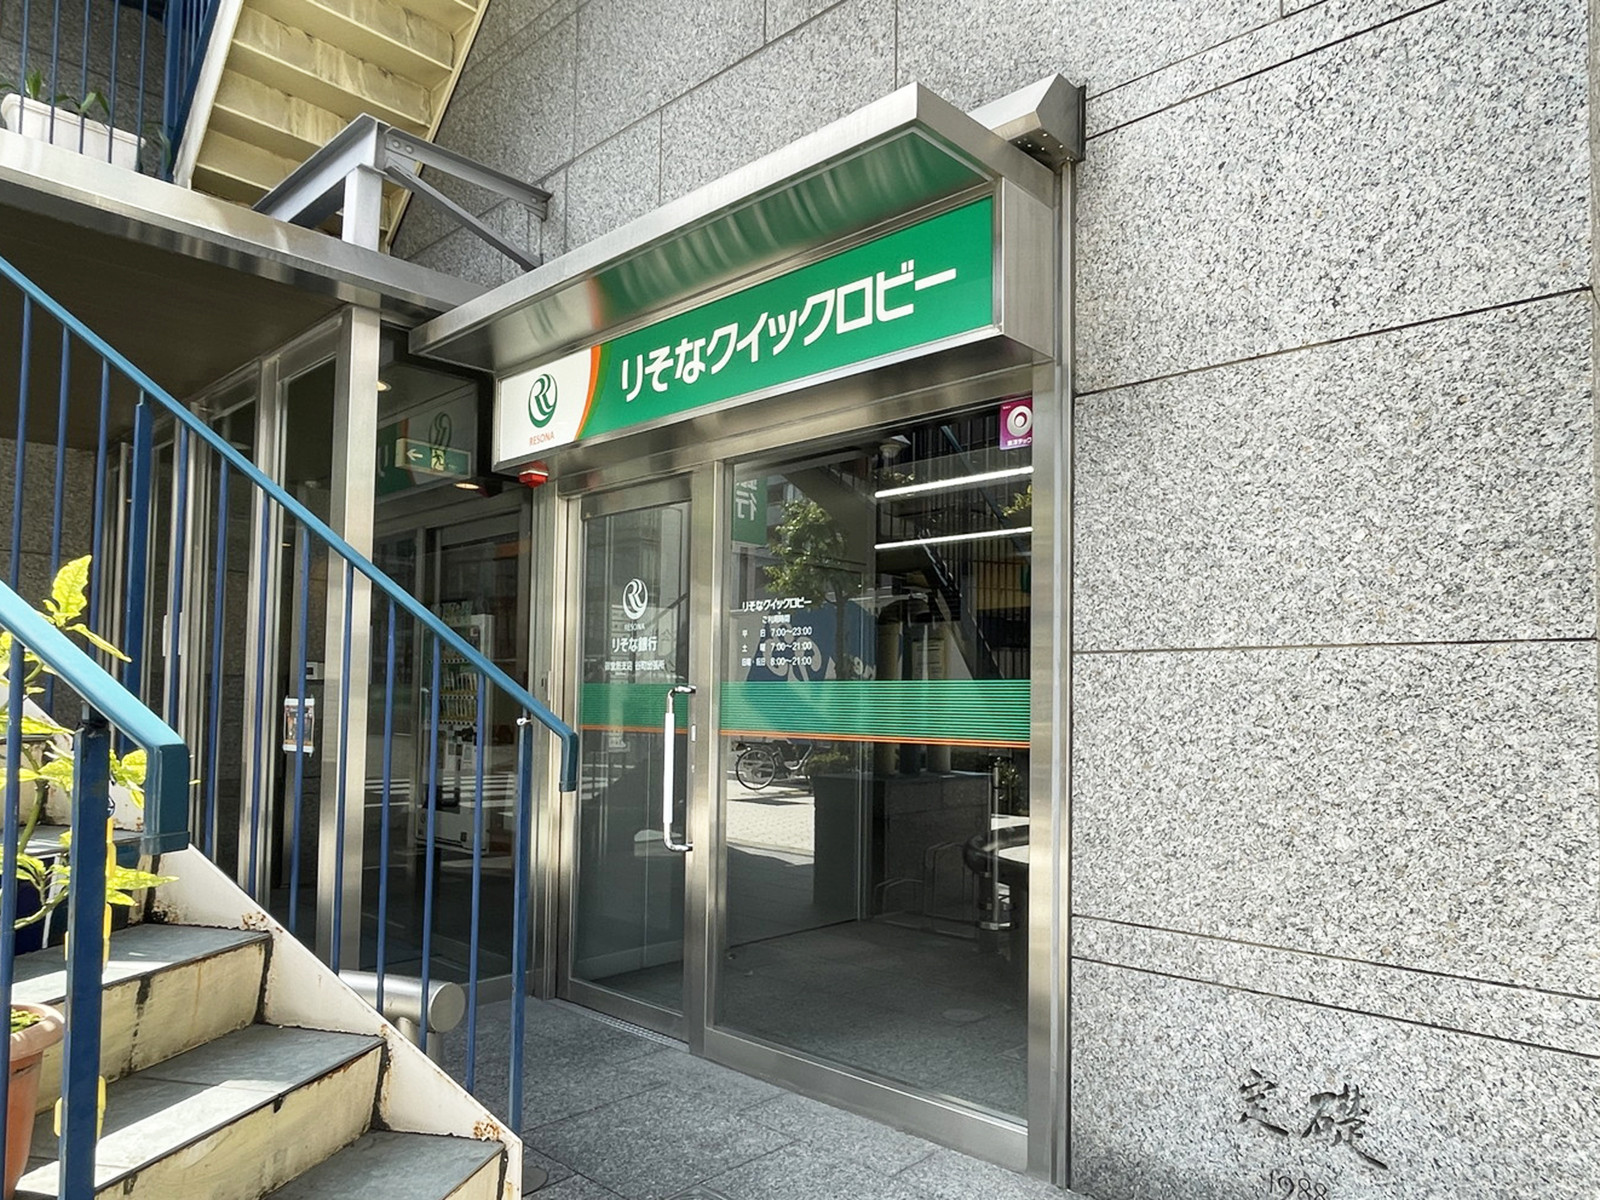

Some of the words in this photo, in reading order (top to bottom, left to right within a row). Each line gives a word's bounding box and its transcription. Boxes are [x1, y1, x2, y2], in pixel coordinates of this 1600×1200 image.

[621, 258, 957, 403] りそなクイックロビー
[529, 431, 555, 446] RESONA
[742, 596, 812, 612] りそなクイックロビー
[611, 636, 657, 653] りそな銀行
[1268, 1167, 1328, 1200] 1988
